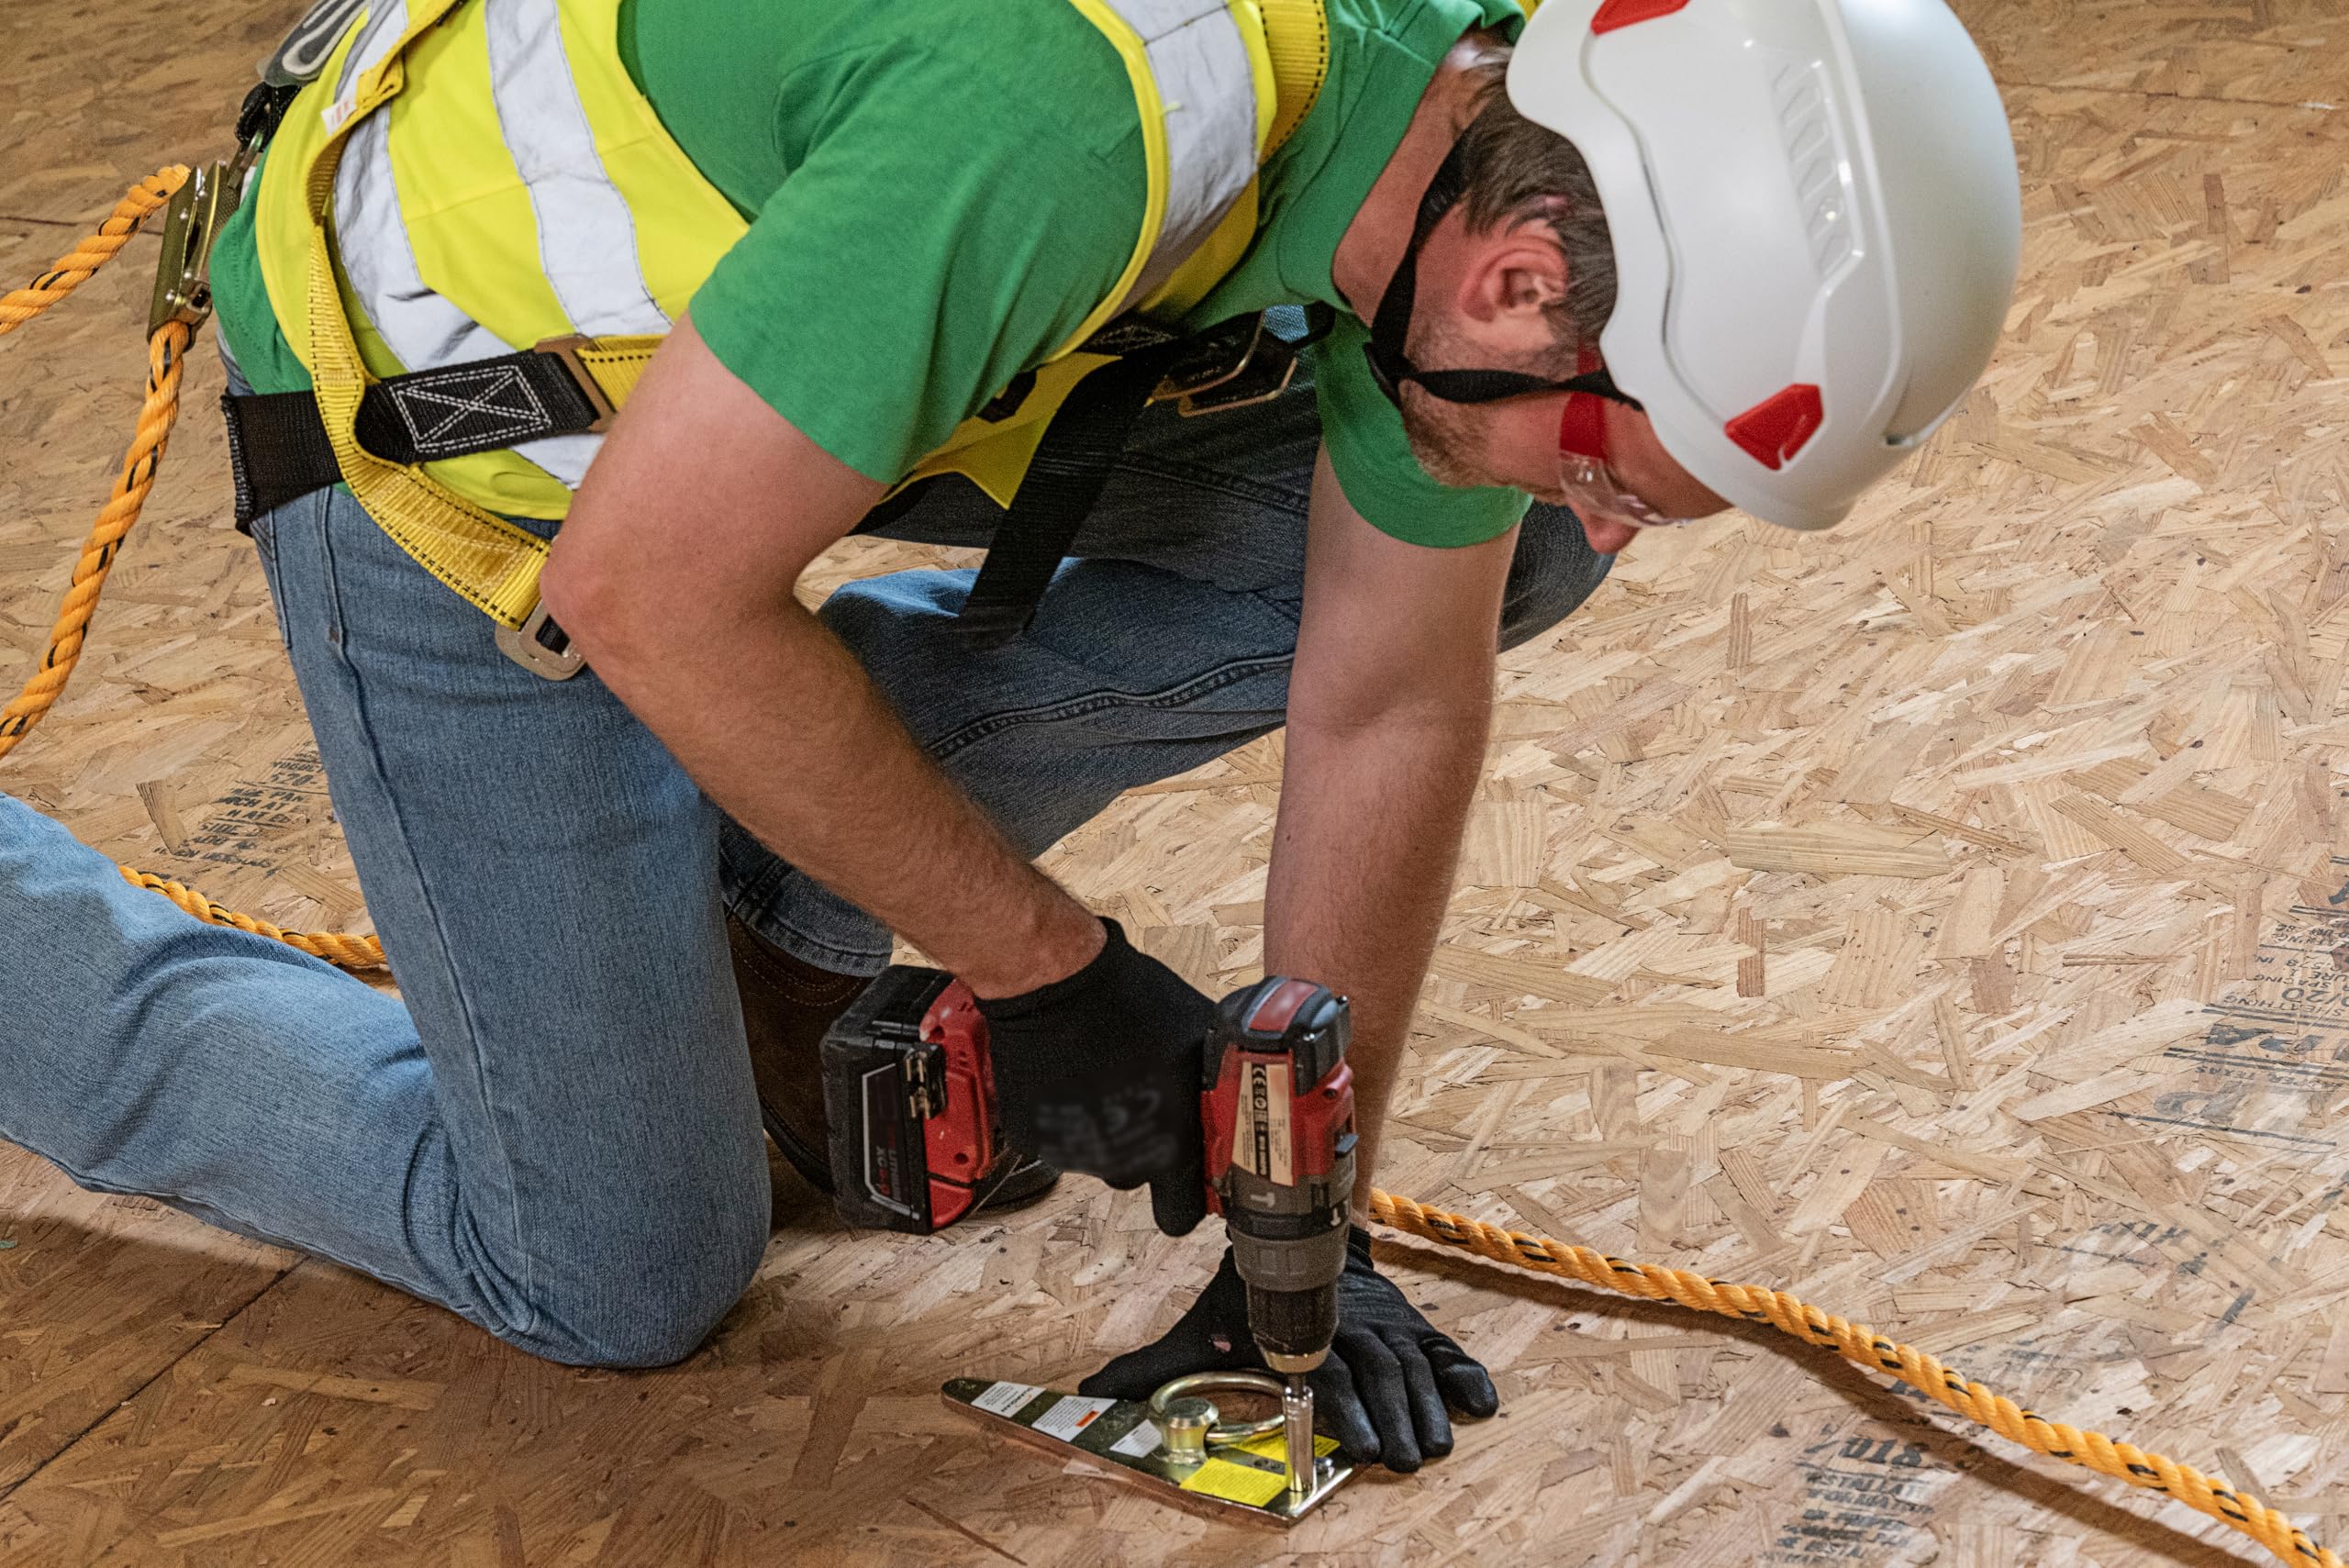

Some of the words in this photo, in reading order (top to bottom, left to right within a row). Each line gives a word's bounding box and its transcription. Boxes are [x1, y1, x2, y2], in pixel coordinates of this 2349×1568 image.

[2254, 973, 2331, 988] SPACING
[2222, 995, 2345, 1017] SHEATHING
[2195, 1065, 2255, 1080] TEXAS
